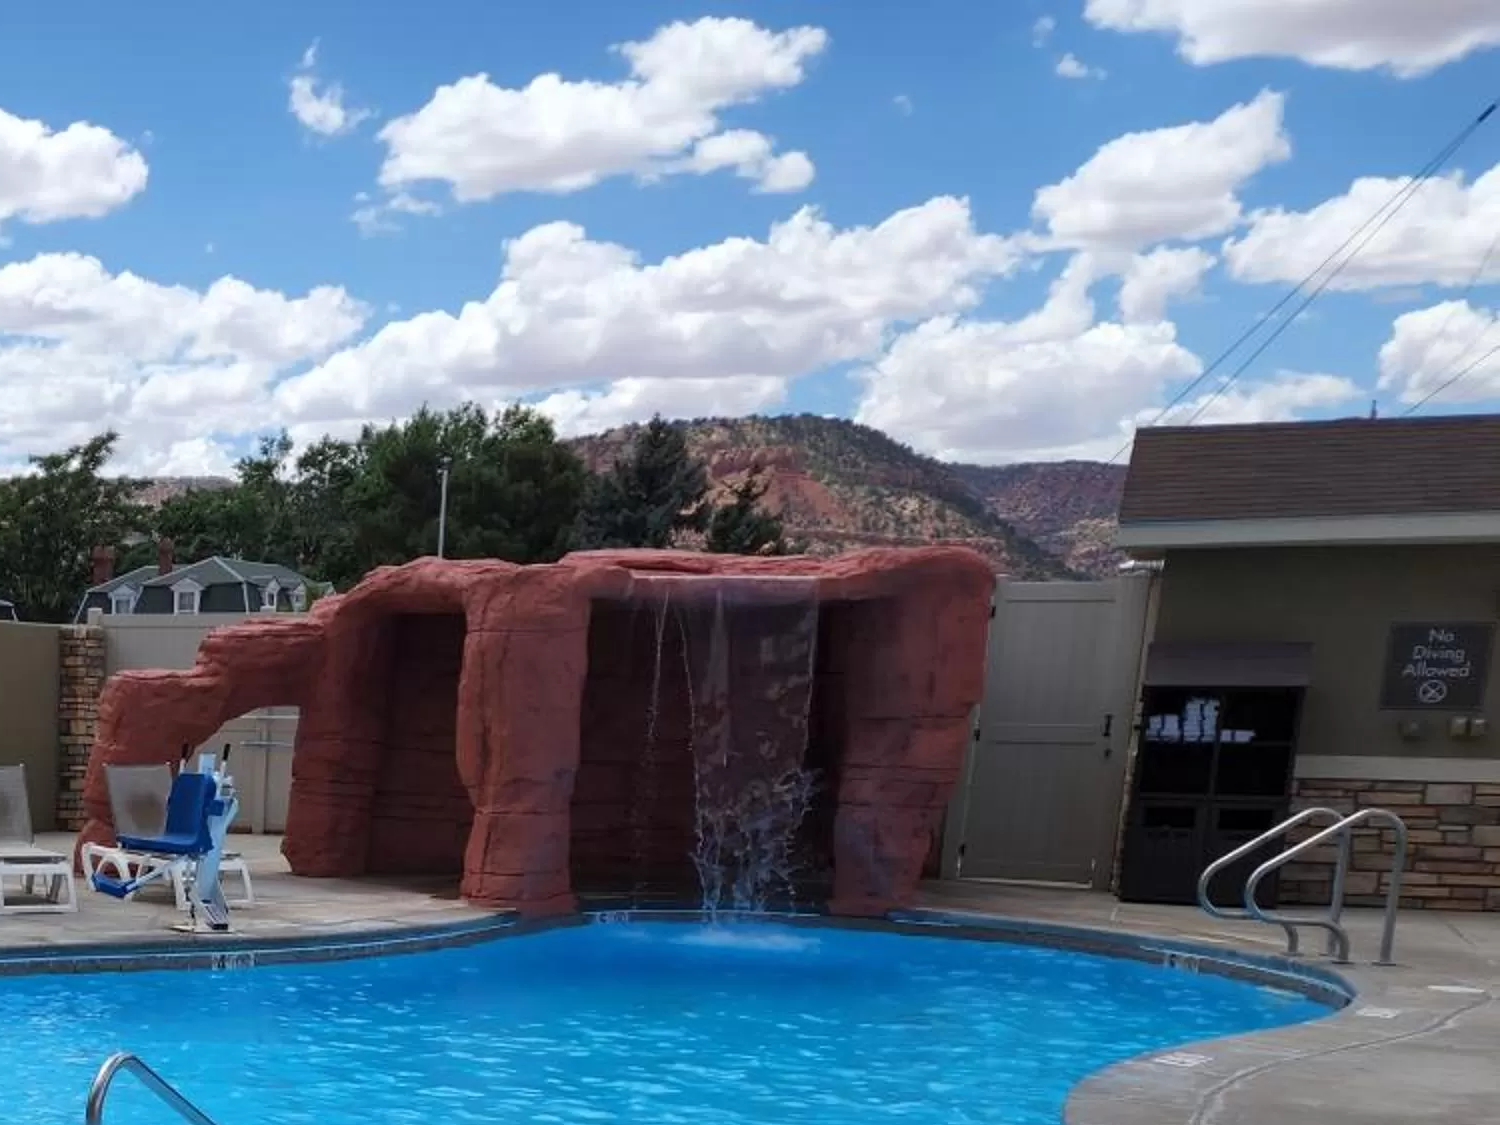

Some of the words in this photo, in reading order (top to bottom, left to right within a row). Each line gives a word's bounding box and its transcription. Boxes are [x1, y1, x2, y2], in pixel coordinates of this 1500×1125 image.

[1428, 628, 1455, 641] No
[1413, 645, 1465, 663] Diving
[1402, 659, 1470, 677] Allowed
